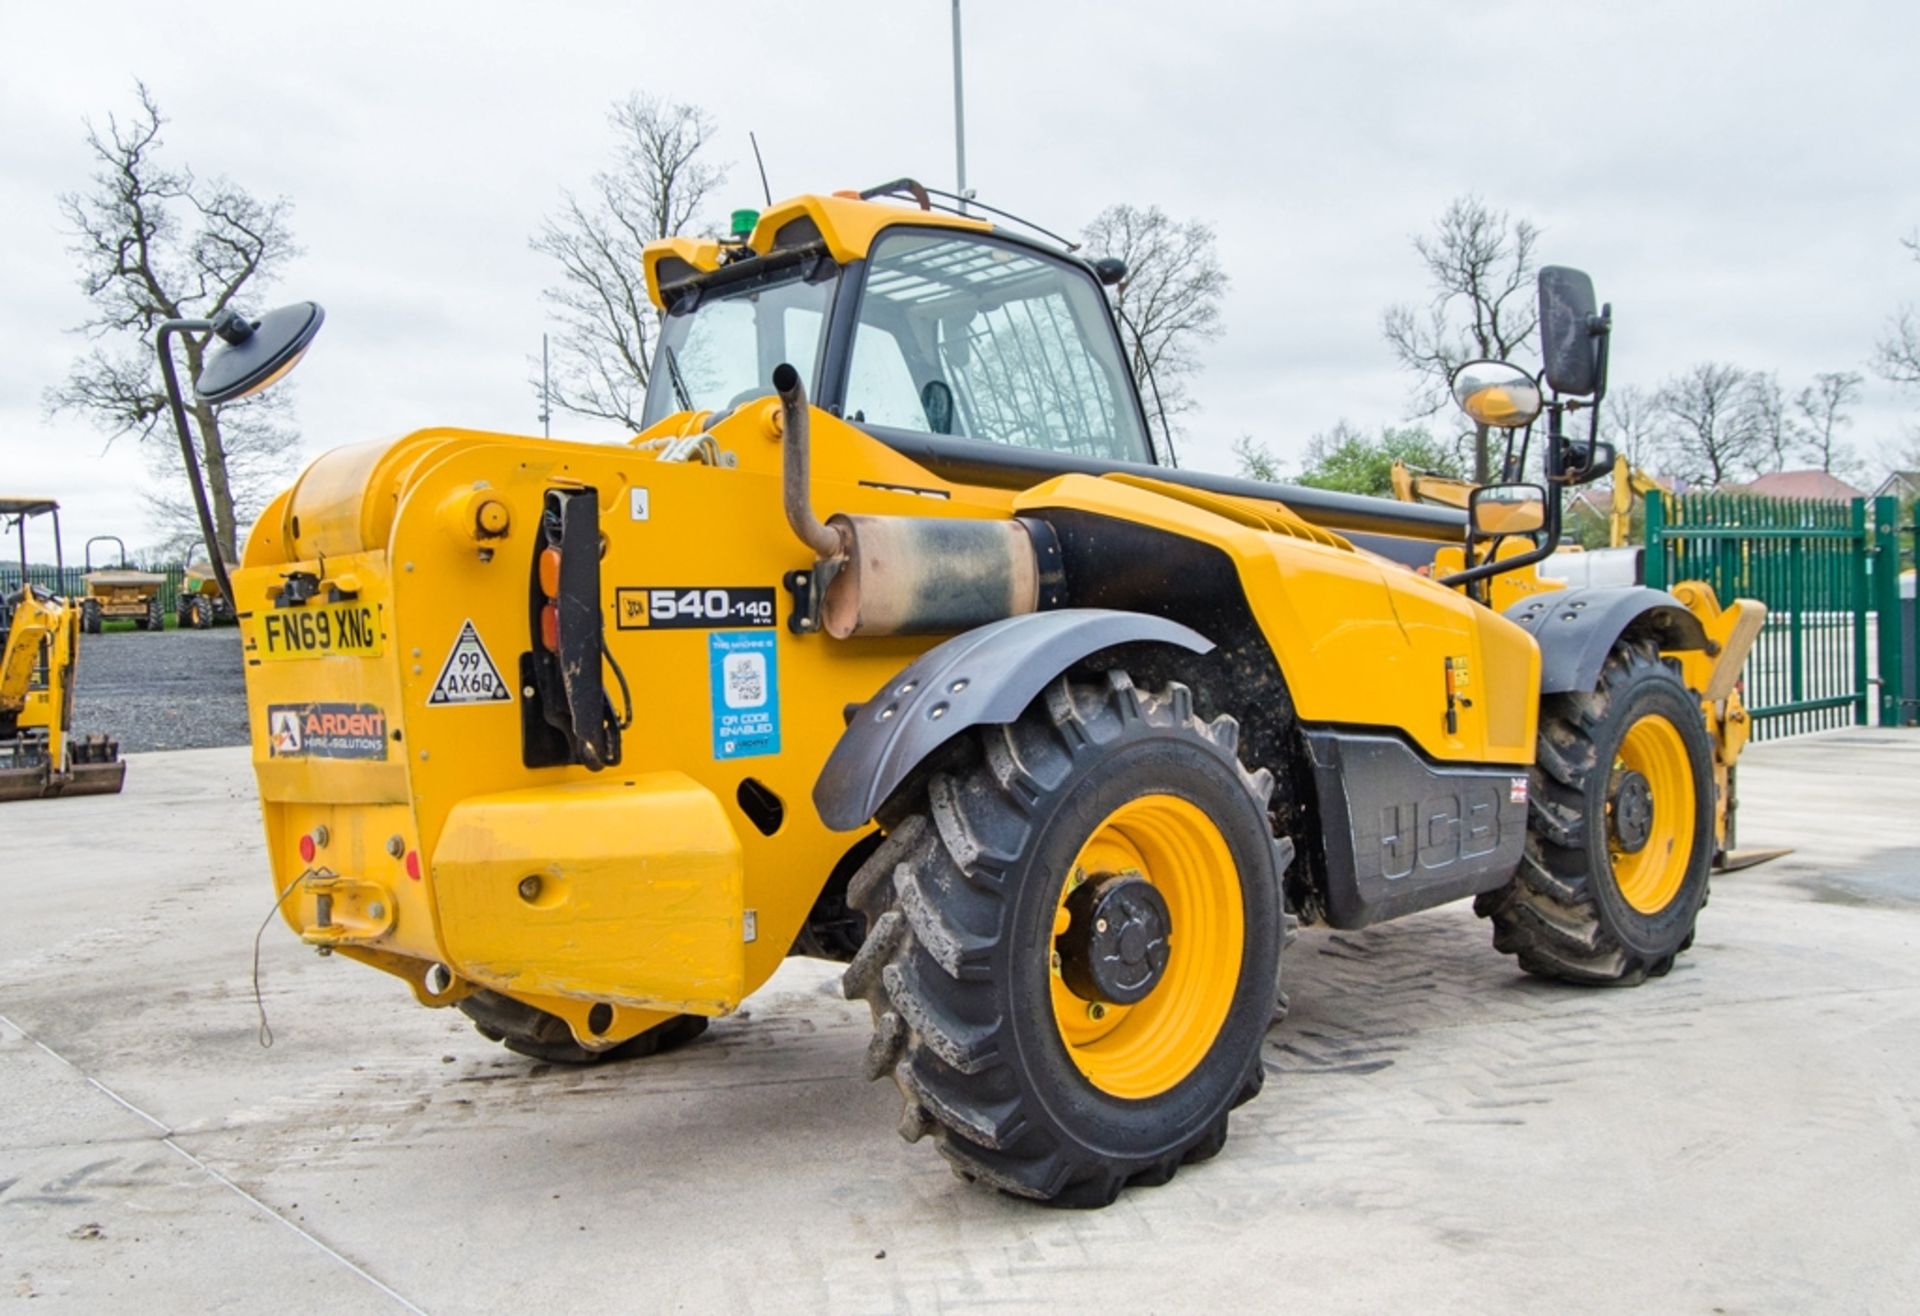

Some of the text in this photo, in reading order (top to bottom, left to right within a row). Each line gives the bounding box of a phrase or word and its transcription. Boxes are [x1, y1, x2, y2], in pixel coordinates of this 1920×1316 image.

[265, 608, 374, 653] FN69 XNG
[459, 652, 481, 672] 99
[448, 672, 493, 694] AX6Q
[304, 713, 384, 736] ARDENT
[1379, 787, 1500, 880] JCB
